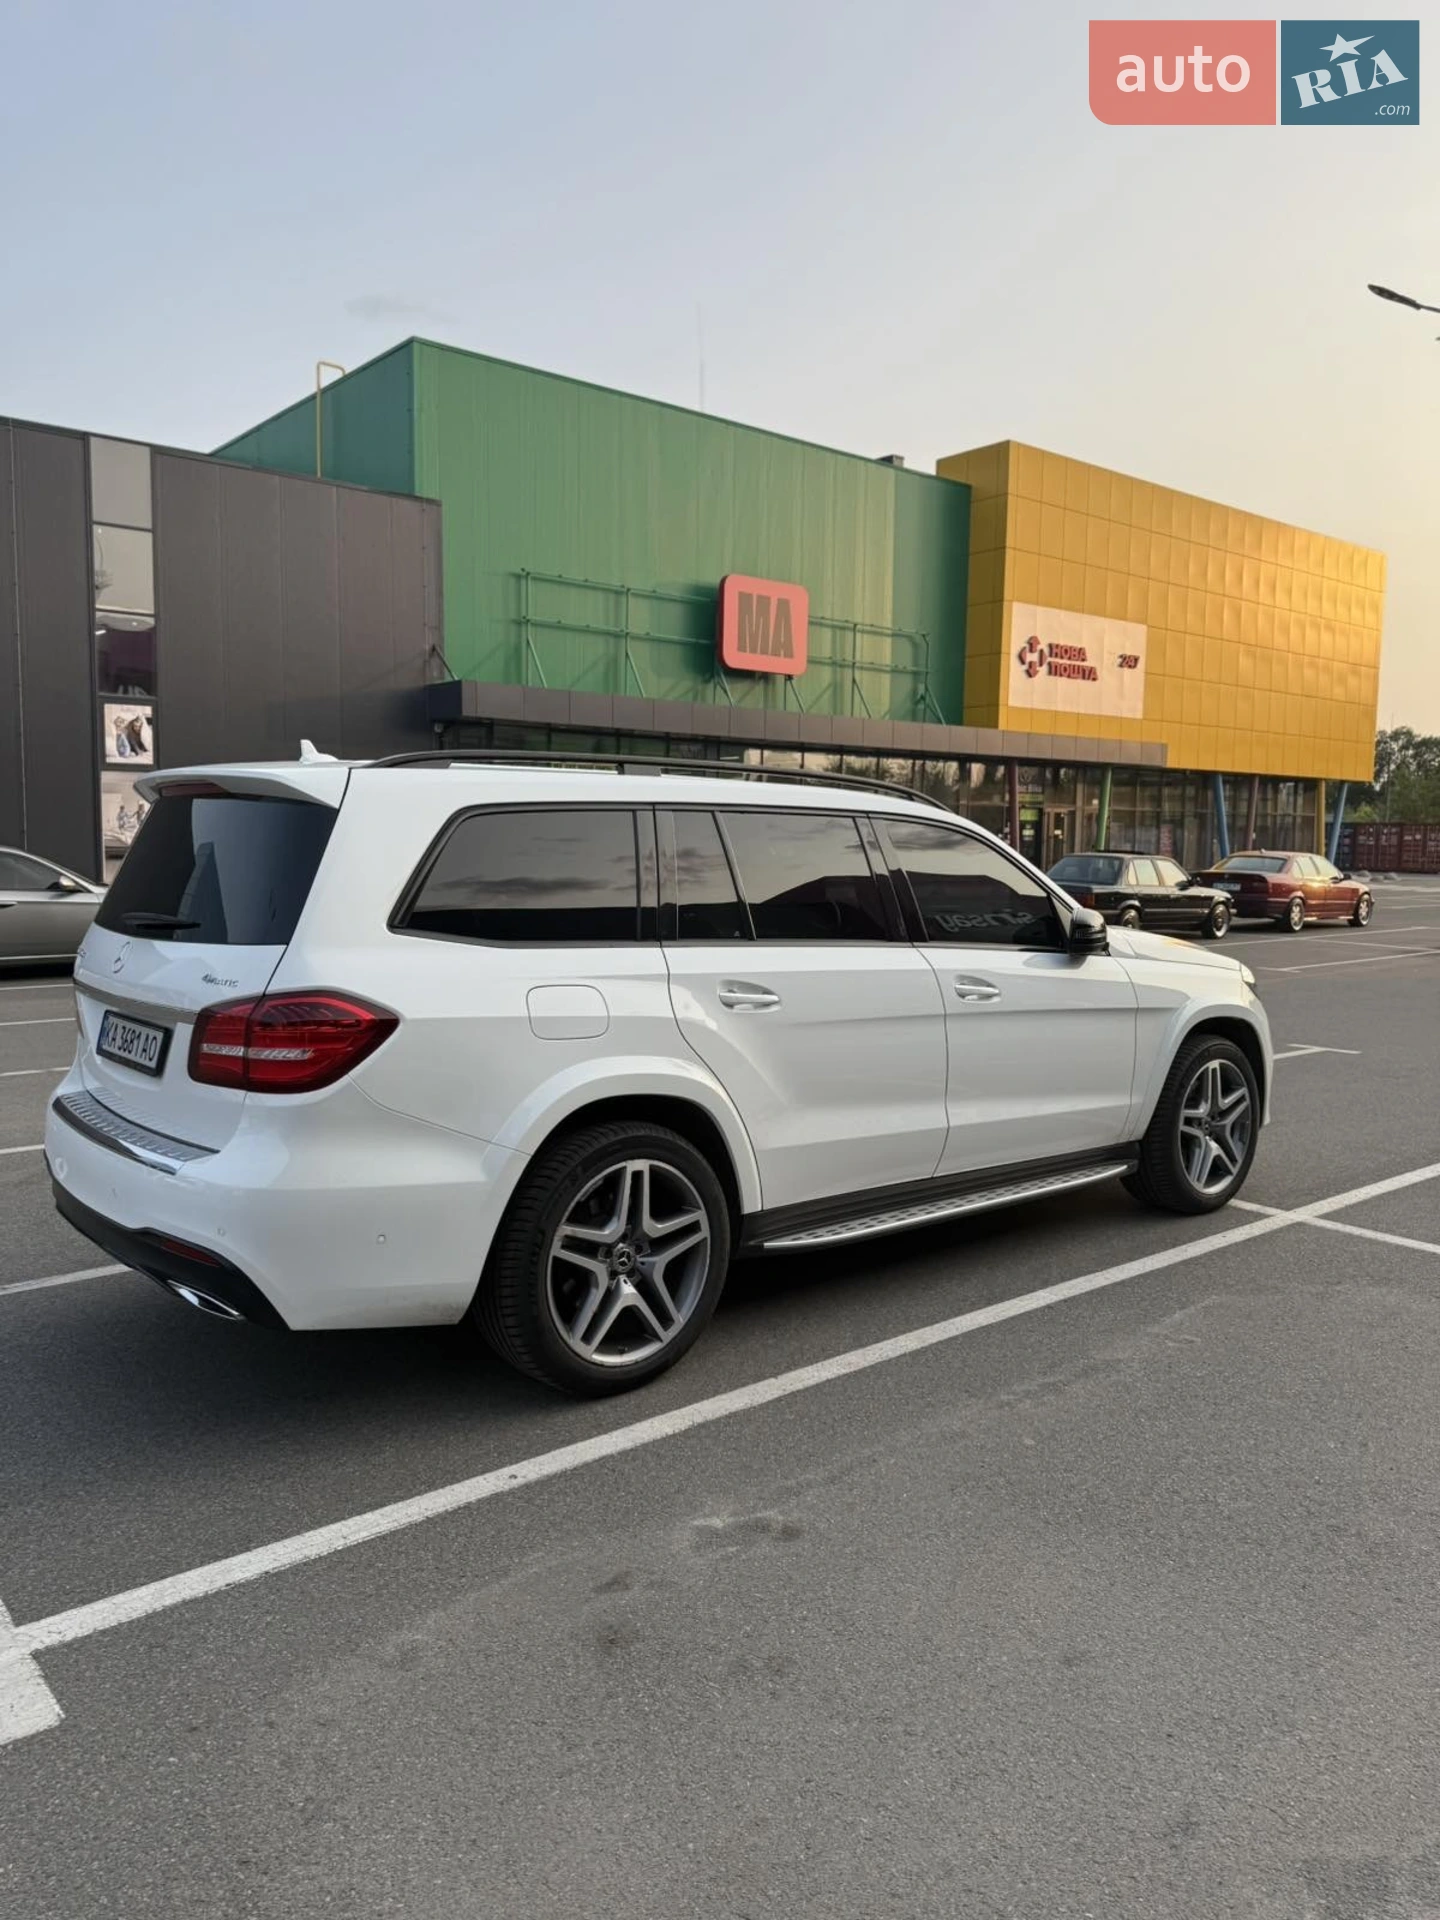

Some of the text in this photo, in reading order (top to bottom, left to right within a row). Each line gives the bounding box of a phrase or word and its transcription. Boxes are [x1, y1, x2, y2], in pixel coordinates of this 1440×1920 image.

[1047, 643, 1088, 662] НОВА
[1047, 661, 1098, 682] ПОШТА
[106, 1021, 157, 1062] KA 3681 AO
